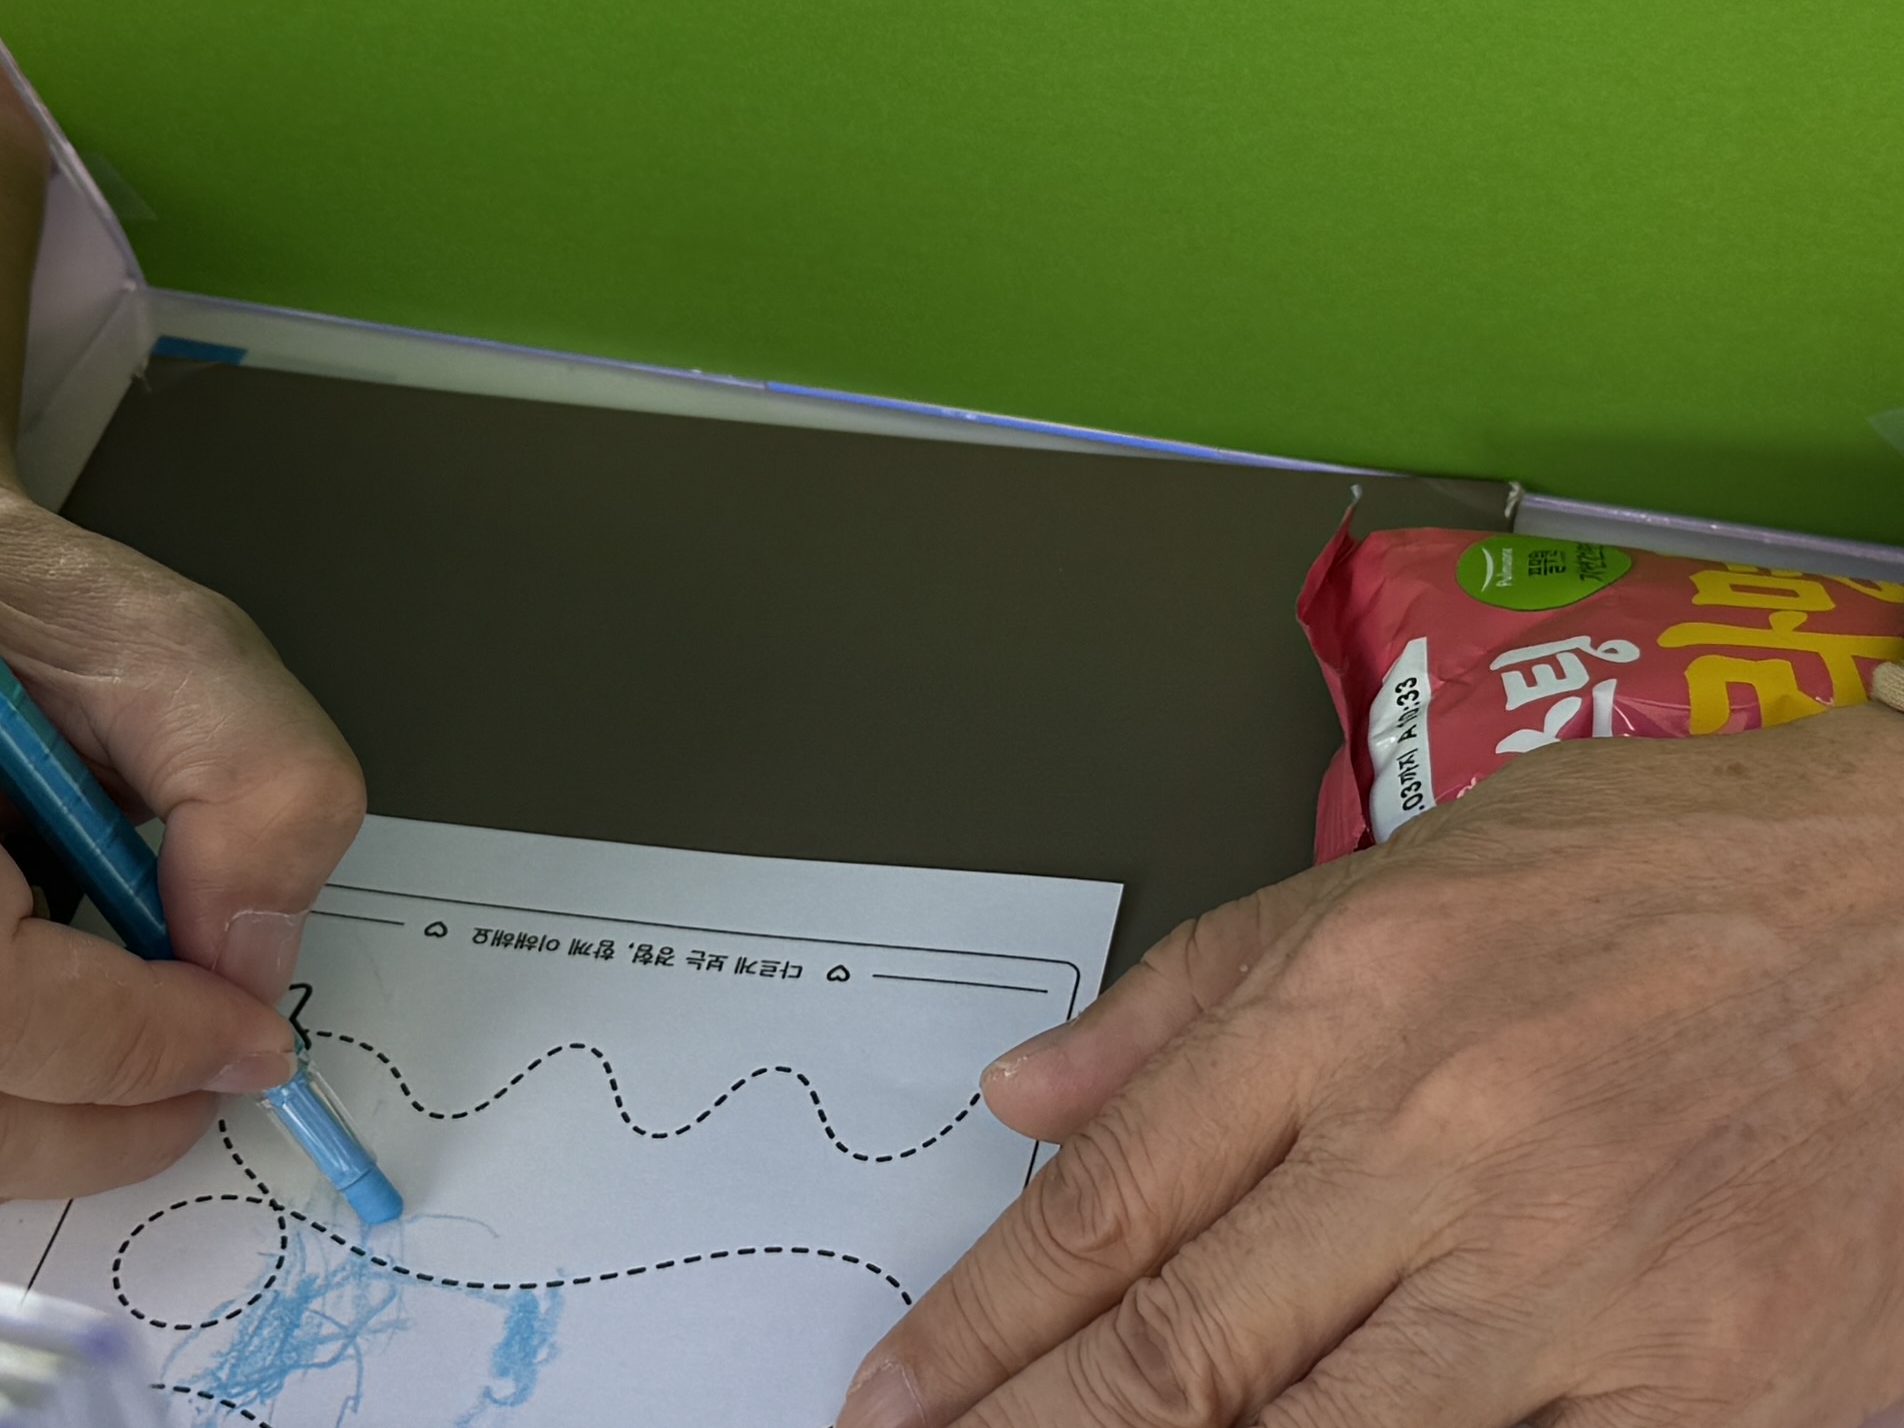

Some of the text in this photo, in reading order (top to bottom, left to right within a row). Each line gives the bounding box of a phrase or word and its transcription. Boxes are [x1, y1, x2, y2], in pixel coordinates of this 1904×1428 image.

[471, 926, 804, 980] 다르게 보는 경험, 함께 이해해요
